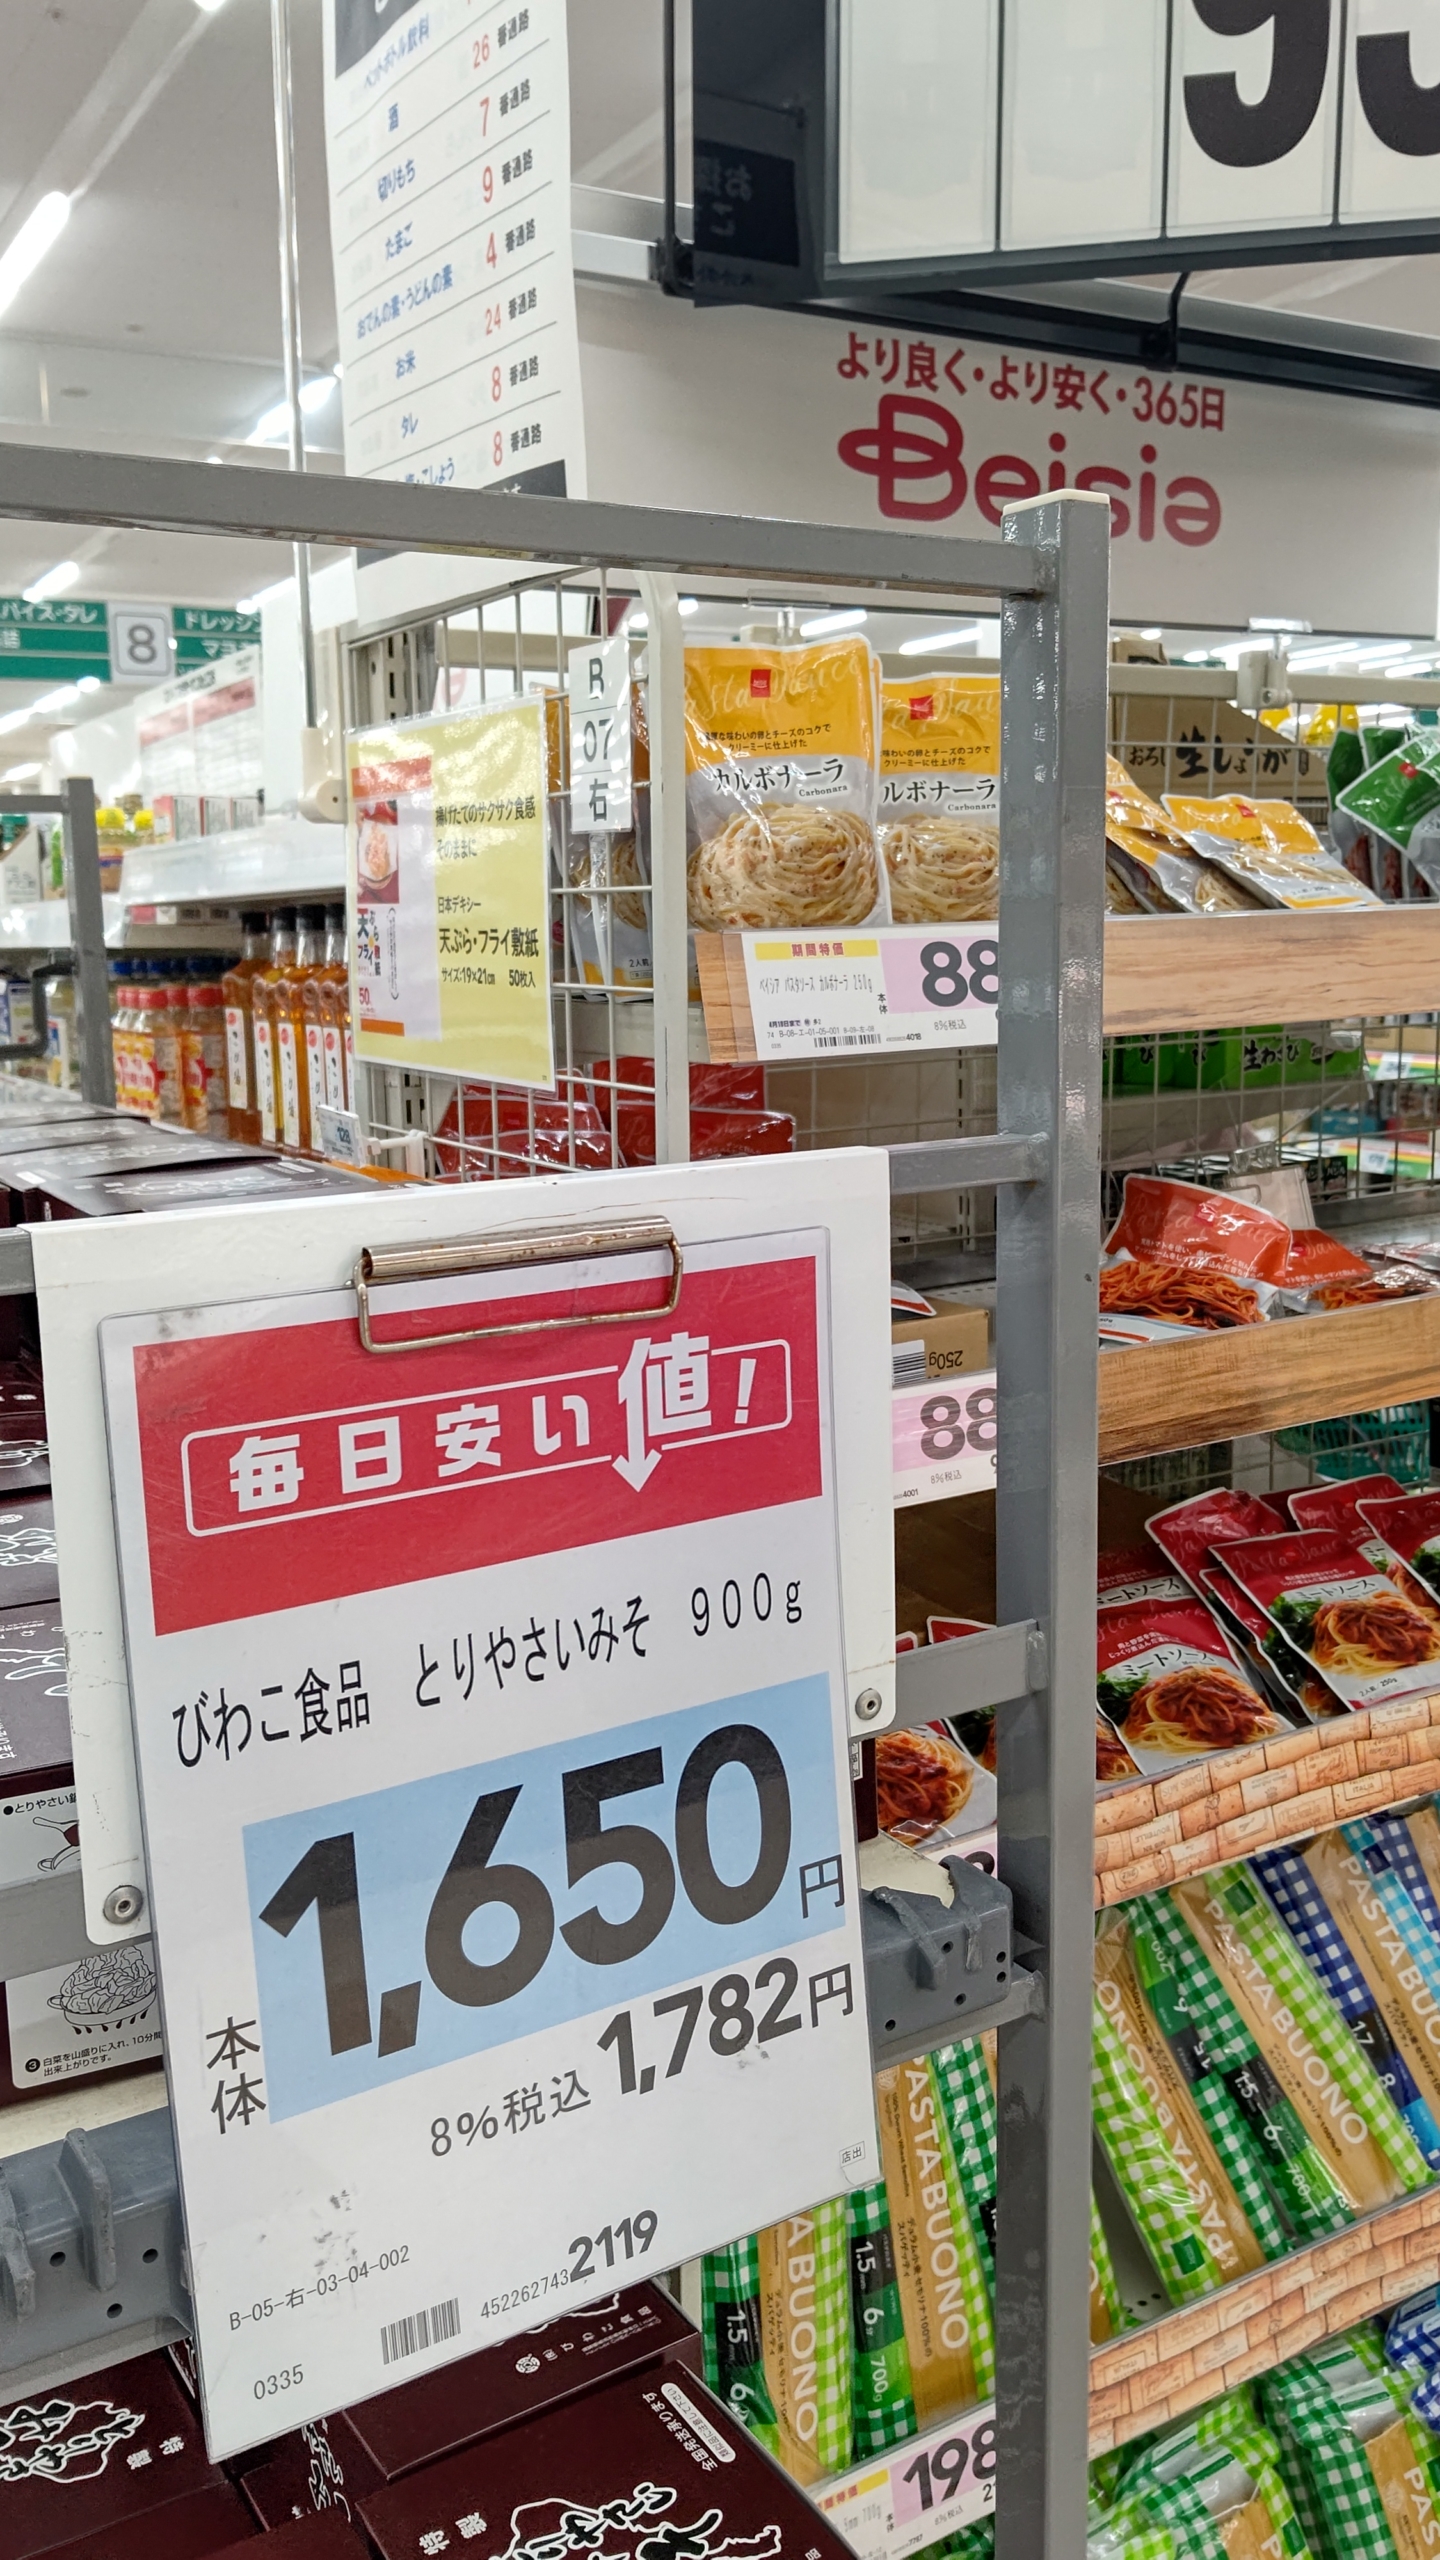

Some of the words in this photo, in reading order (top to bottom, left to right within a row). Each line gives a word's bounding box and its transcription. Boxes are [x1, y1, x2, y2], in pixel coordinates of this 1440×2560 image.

[473, 33, 489, 70] 26
[497, 8, 529, 48] 番通路
[480, 97, 489, 137] 7
[499, 79, 531, 117] 番通路
[377, 159, 415, 202] 切りもち
[483, 166, 493, 203] 9
[502, 149, 532, 185] 番通路
[385, 222, 413, 260] たまご
[486, 232, 497, 268] 4
[505, 218, 535, 253] 番通路
[357, 264, 453, 339] おでんの素・うどんの素
[485, 304, 501, 336] 24
[508, 287, 537, 320] 番通路
[395, 350, 416, 379] お米
[492, 366, 501, 402] 8
[509, 355, 539, 387] 番通路
[837, 332, 1226, 431] より良く・より安く・365日
[401, 413, 418, 438] タレ
[493, 431, 502, 466] 8
[510, 423, 541, 453] 番通路
[838, 393, 1222, 547] Beisia
[128, 624, 157, 665] 8
[589, 657, 605, 699] B
[583, 719, 614, 762] 07
[728, 739, 808, 752] クリーミーに仕上げた
[880, 746, 991, 758] 味わいの卵とチーズのコクで
[1129, 747, 1166, 767] おろし
[1176, 725, 1291, 778] 生しょうが
[713, 758, 844, 792] カルボナーラ
[884, 757, 966, 767] クリーミーに仕上げた
[589, 777, 609, 823] 右
[798, 784, 848, 797] Carbonara
[883, 778, 995, 803] ルボナーラ
[947, 803, 997, 811] Carbonara
[435, 795, 536, 828] 揚げたてのサクサク食感
[436, 838, 477, 861] そのままに
[438, 896, 481, 914] 日本デキシー
[439, 927, 539, 958] 天ぷら・フライ敷紙
[791, 942, 845, 957] 期間特価
[509, 969, 536, 988] 50枚入
[853, 974, 873, 992] 250g
[919, 939, 999, 1007] 88
[877, 993, 888, 1015] 本体
[933, 1019, 967, 1031] 8%税込
[1243, 1035, 1300, 1071] 生わさび
[929, 1350, 963, 1369] 250g
[228, 1332, 757, 1513] 毎日安い値!
[920, 1388, 997, 1460] 88
[930, 1470, 962, 1485] 8%税込
[1297, 1579, 1375, 1600] ミートソース
[172, 1660, 371, 1768] びわこ食品
[415, 1595, 651, 1709] とりやさいみそ
[691, 1572, 803, 1636] 900g
[1121, 1649, 1215, 1676] ミートソース
[259, 1723, 845, 2058] 1,650円
[1339, 1857, 1407, 1966] PASTA
[1204, 1900, 1276, 2010] PASTA
[1272, 2006, 1368, 2144] BUONO
[43, 2030, 162, 2067] 白菜を山盛りに入れ、10分間
[43, 2056, 112, 2077] 出来上がりです。
[429, 2071, 591, 2157] 8%税込
[596, 1957, 854, 2097] 1,782円
[1097, 1980, 1174, 2129] BUONO
[205, 2015, 268, 2135] 本体
[1380, 2073, 1396, 2090] 8
[1264, 2124, 1283, 2142] 6
[842, 2146, 862, 2164] 店出
[855, 2242, 876, 2273] 1.5
[921, 2180, 969, 2349] BUONO
[229, 2245, 411, 2331] B-05-右-03-04-002
[727, 2309, 748, 2344] 1.5
[863, 2307, 884, 2325] 6
[788, 2253, 818, 2441] BUONO
[253, 2364, 304, 2401] 0335
[730, 2382, 756, 2401] 6
[642, 2391, 718, 2472] 全国発送承ります
[903, 2419, 996, 2512] 198
[934, 2505, 963, 2526] 8%税込
[1403, 2467, 1440, 2545] PAS
[419, 2511, 488, 2555] 特製
